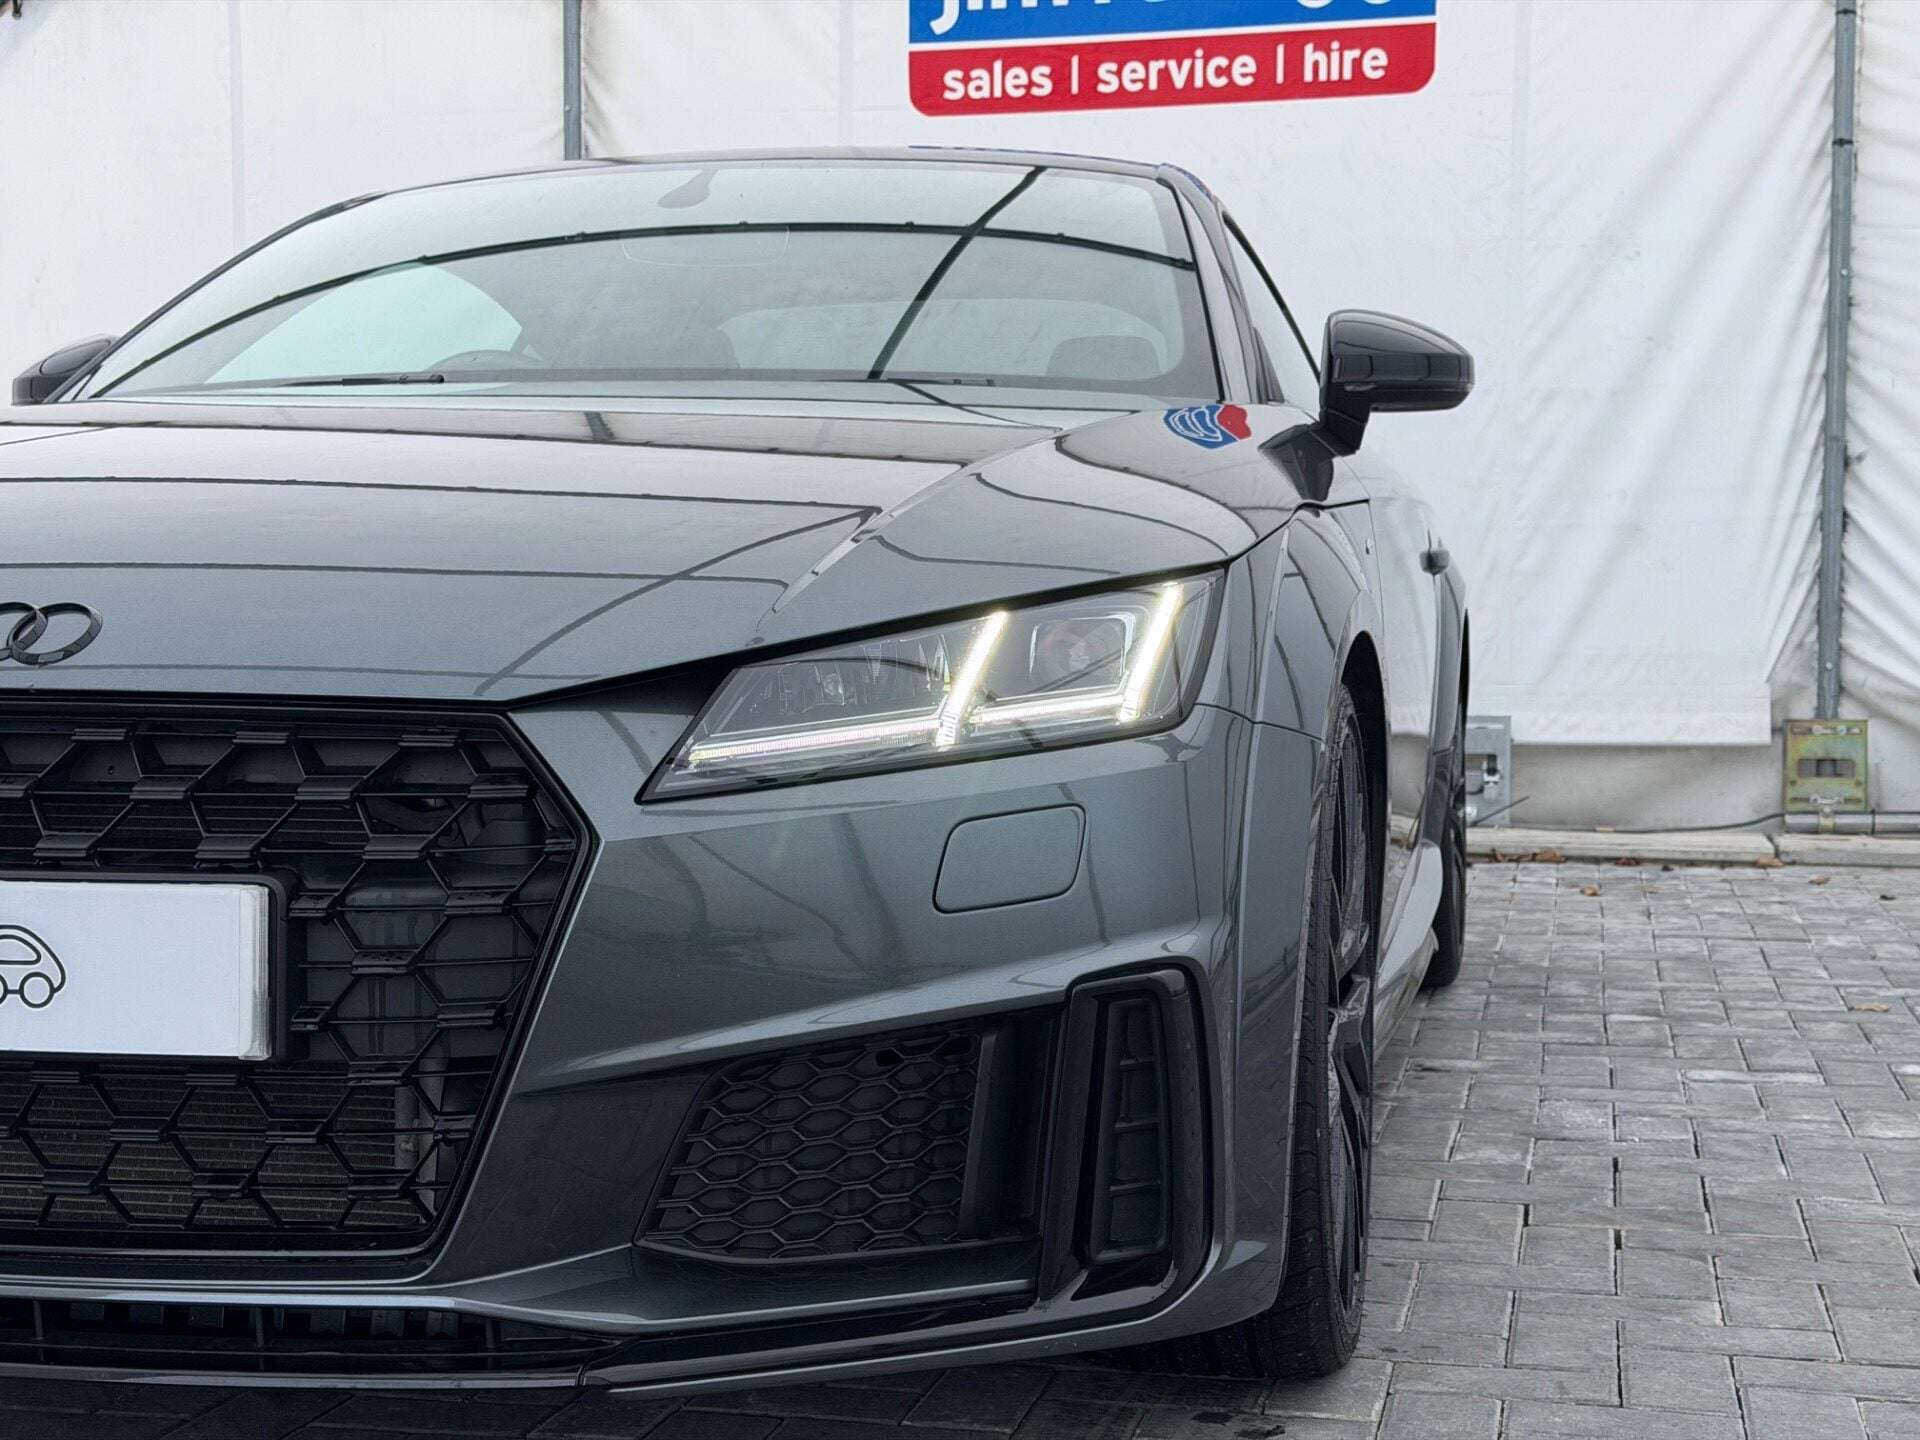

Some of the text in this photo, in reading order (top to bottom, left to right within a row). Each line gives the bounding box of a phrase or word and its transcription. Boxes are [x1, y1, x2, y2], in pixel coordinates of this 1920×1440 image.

[943, 59, 1053, 101] sales
[1097, 48, 1257, 94] service
[1303, 40, 1389, 83] hire
